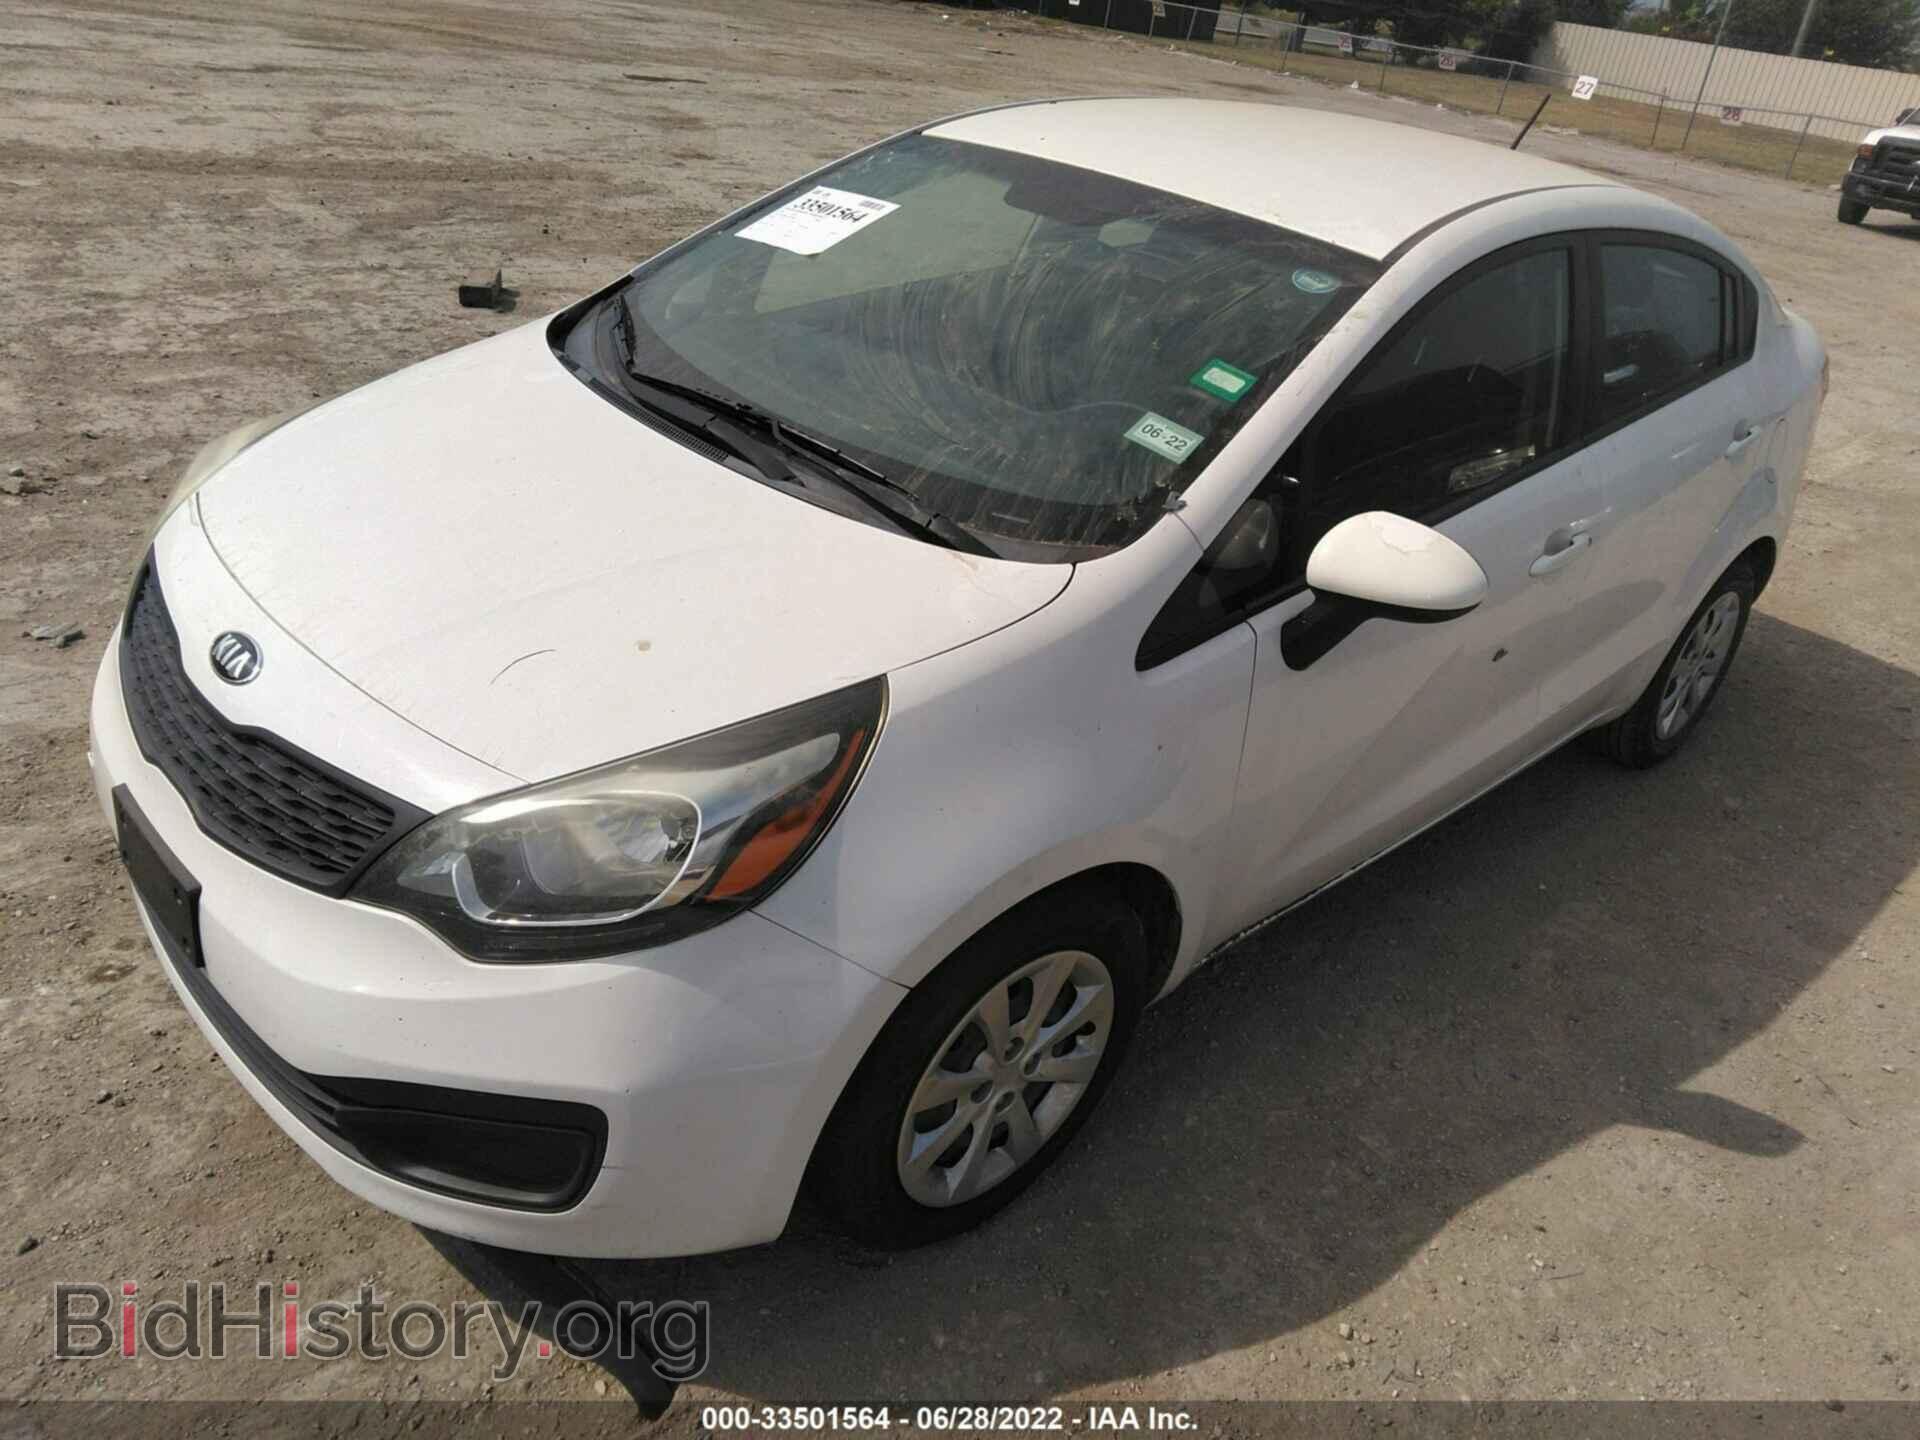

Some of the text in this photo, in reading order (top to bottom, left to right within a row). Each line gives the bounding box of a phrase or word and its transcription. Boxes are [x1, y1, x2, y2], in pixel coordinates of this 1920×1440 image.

[1574, 80, 1594, 96] 27
[1721, 106, 1740, 122] 28
[793, 198, 870, 223] 33501564
[1142, 424, 1188, 451] 06-22
[212, 634, 252, 678] KIA
